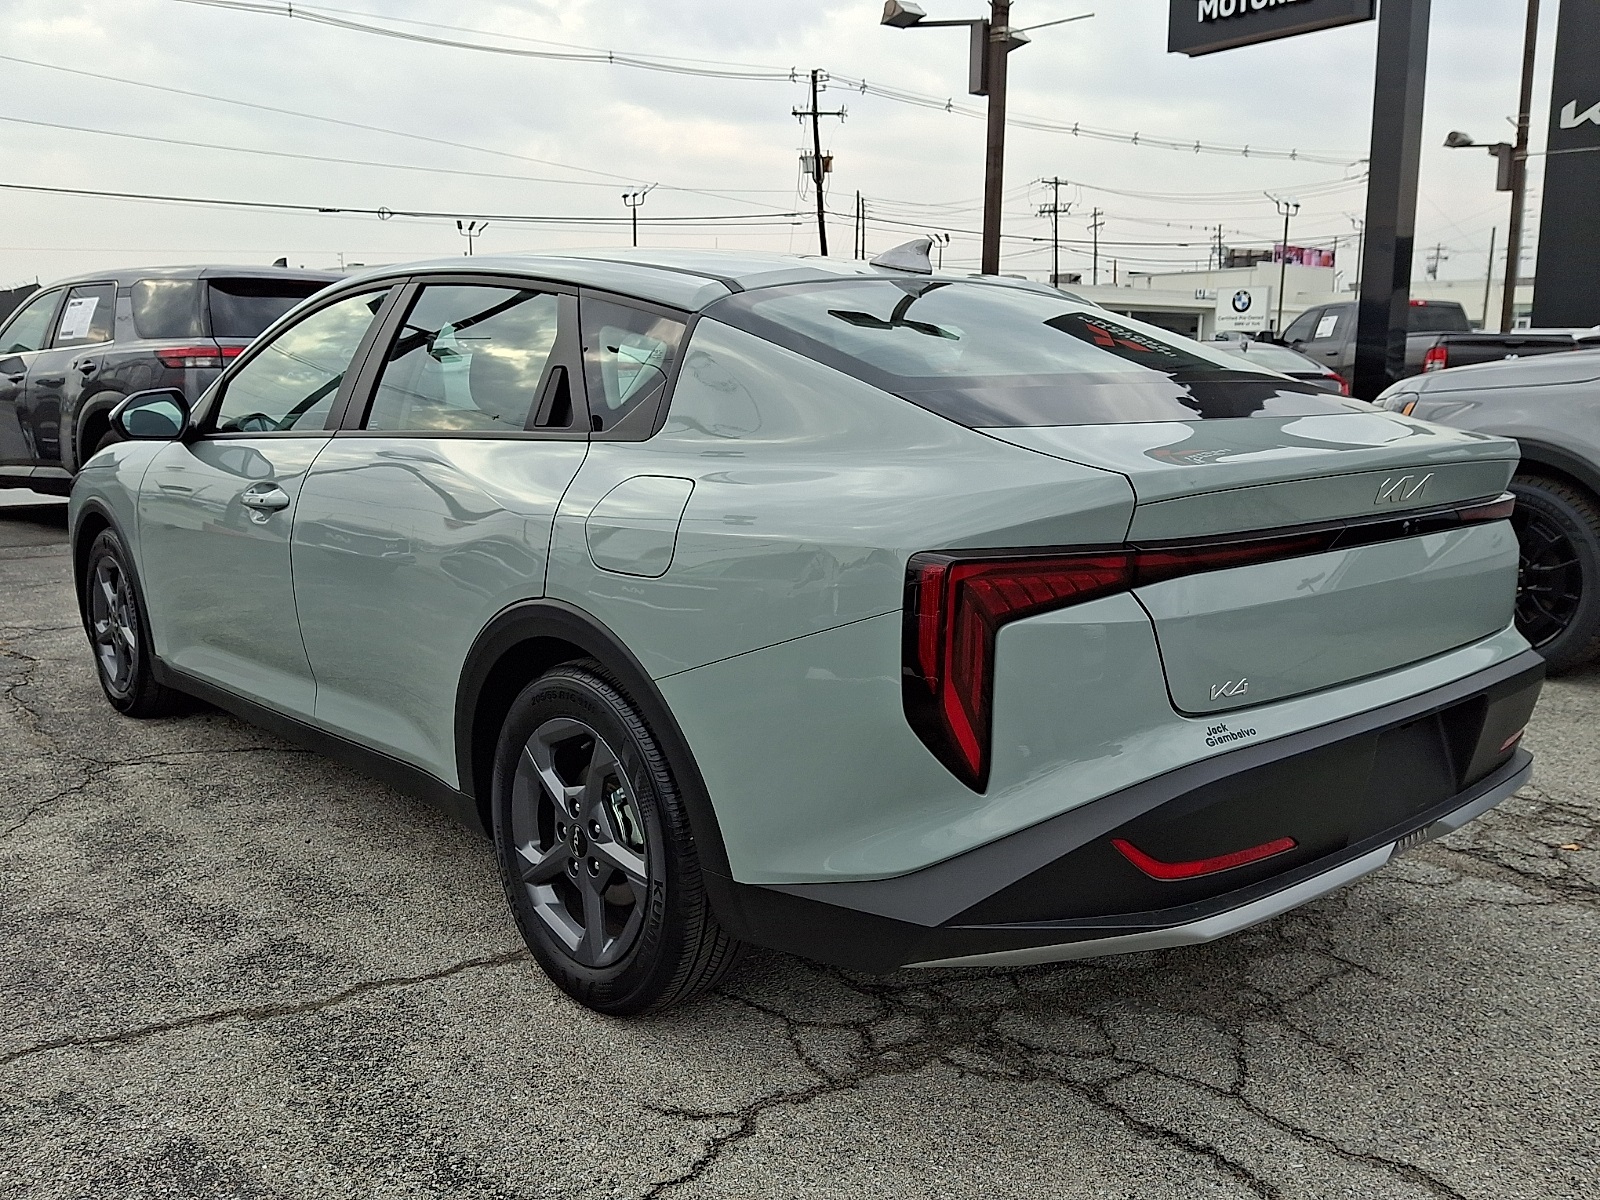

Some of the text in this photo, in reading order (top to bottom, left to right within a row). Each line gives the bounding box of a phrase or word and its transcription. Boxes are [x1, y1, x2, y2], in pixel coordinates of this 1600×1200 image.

[1374, 473, 1434, 505] KIA
[1209, 678, 1248, 701] K4
[1205, 728, 1257, 747] Giambalvo
[1206, 722, 1229, 737] Jack
